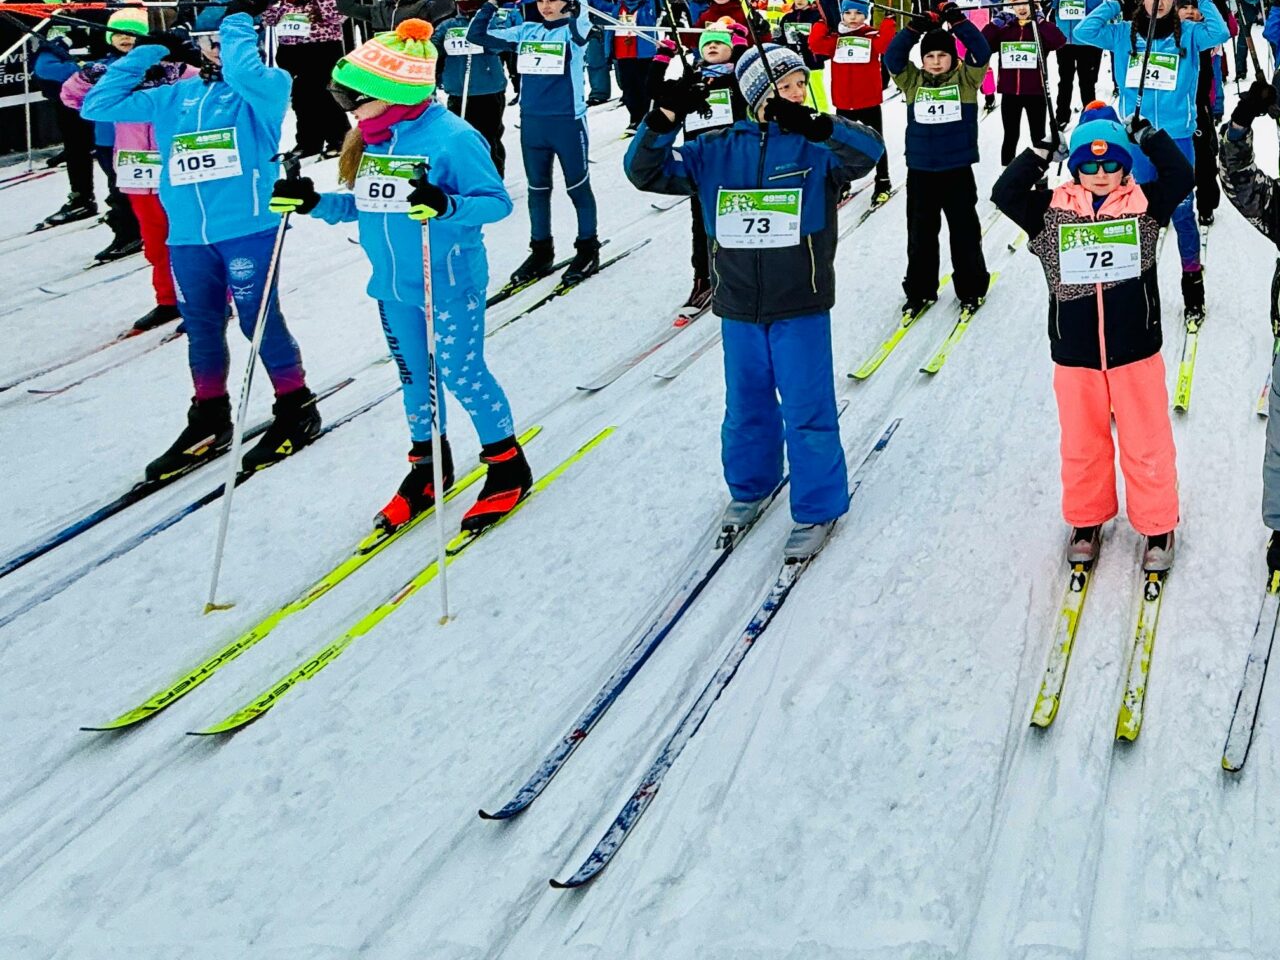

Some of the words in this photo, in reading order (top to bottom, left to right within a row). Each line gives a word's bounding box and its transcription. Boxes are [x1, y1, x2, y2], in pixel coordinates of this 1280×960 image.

[847, 48, 854, 57] 6
[1009, 54, 1028, 62] 124
[533, 56, 542, 66] 7
[927, 104, 945, 115] 41
[177, 153, 216, 172] 105
[133, 168, 153, 179] 21
[368, 182, 396, 199] 60
[742, 217, 771, 234] 73
[1086, 250, 1114, 269] 72
